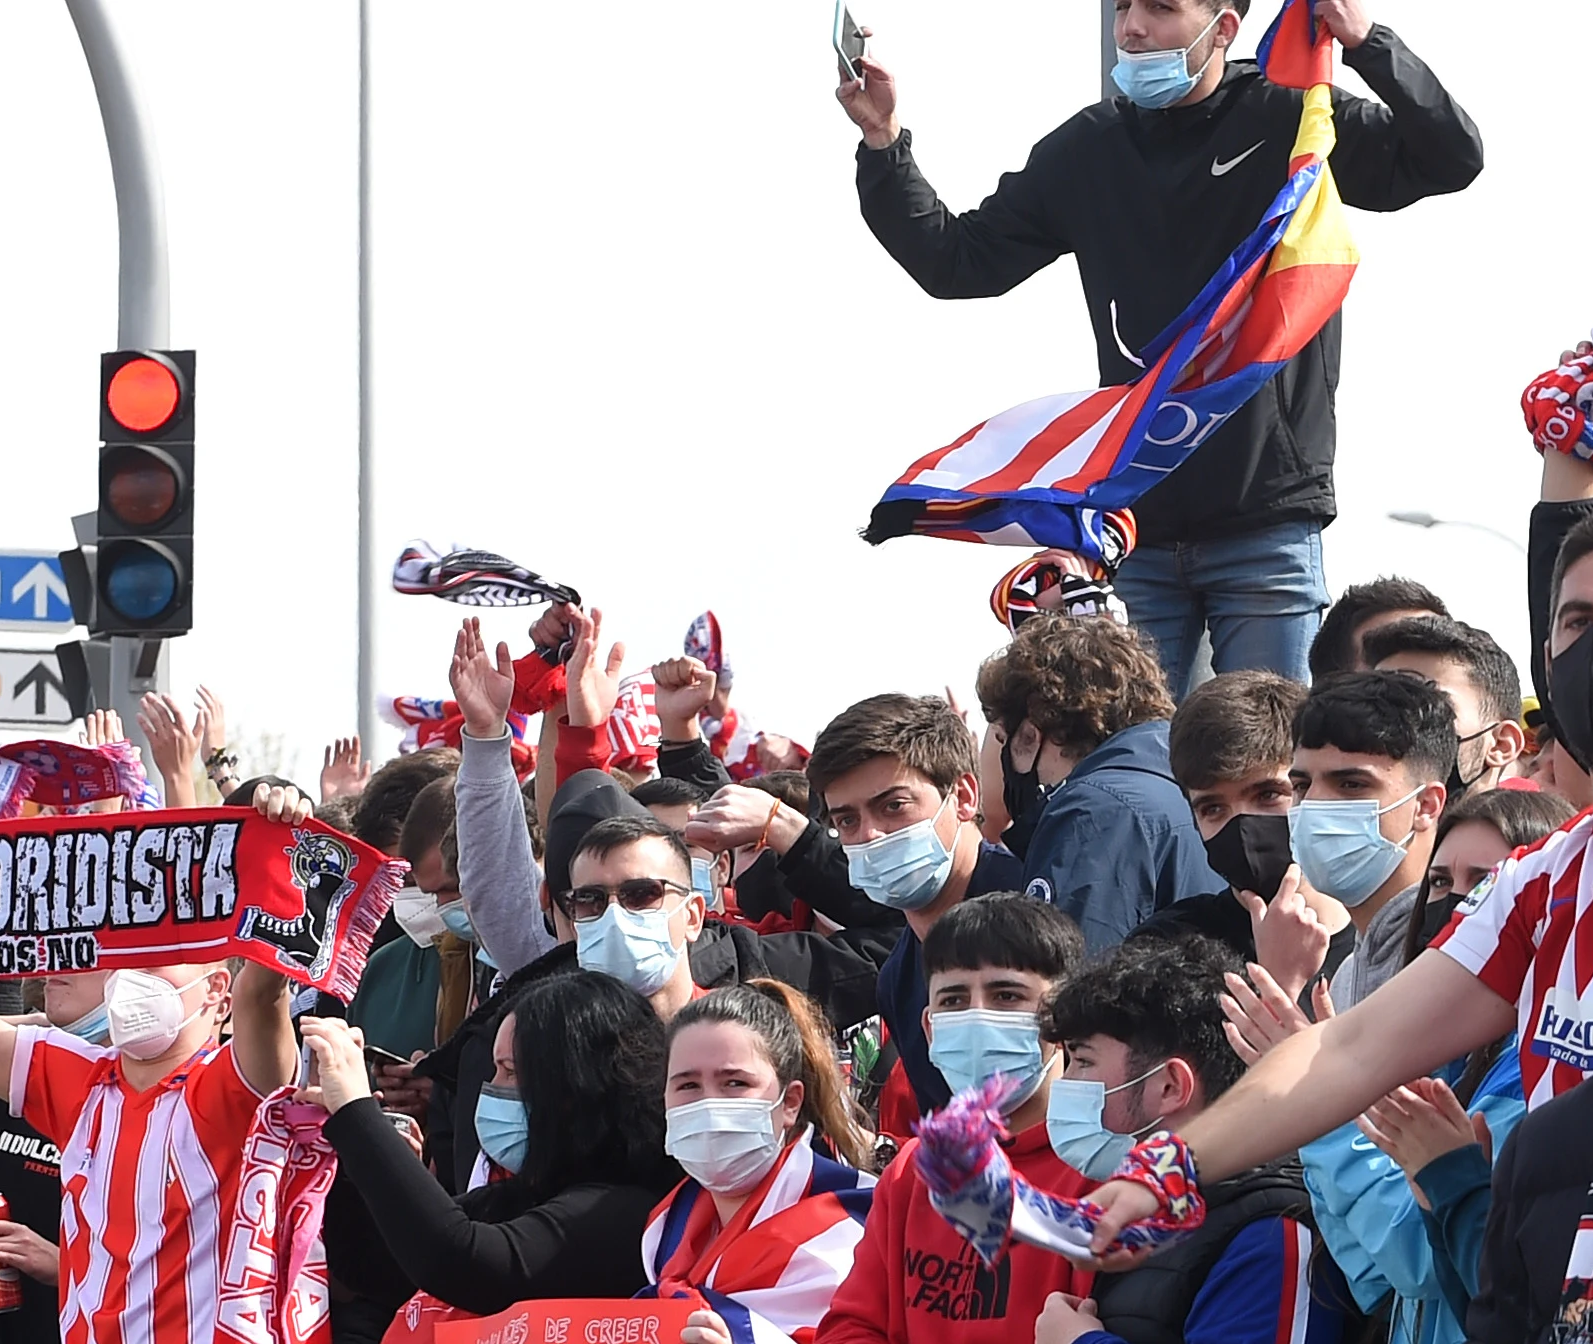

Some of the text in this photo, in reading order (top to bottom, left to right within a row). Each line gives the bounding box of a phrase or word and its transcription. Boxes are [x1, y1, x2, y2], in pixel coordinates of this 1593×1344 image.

[45, 934, 99, 973] NO
[905, 1247, 979, 1293] NORT
[544, 1317, 572, 1344] DE
